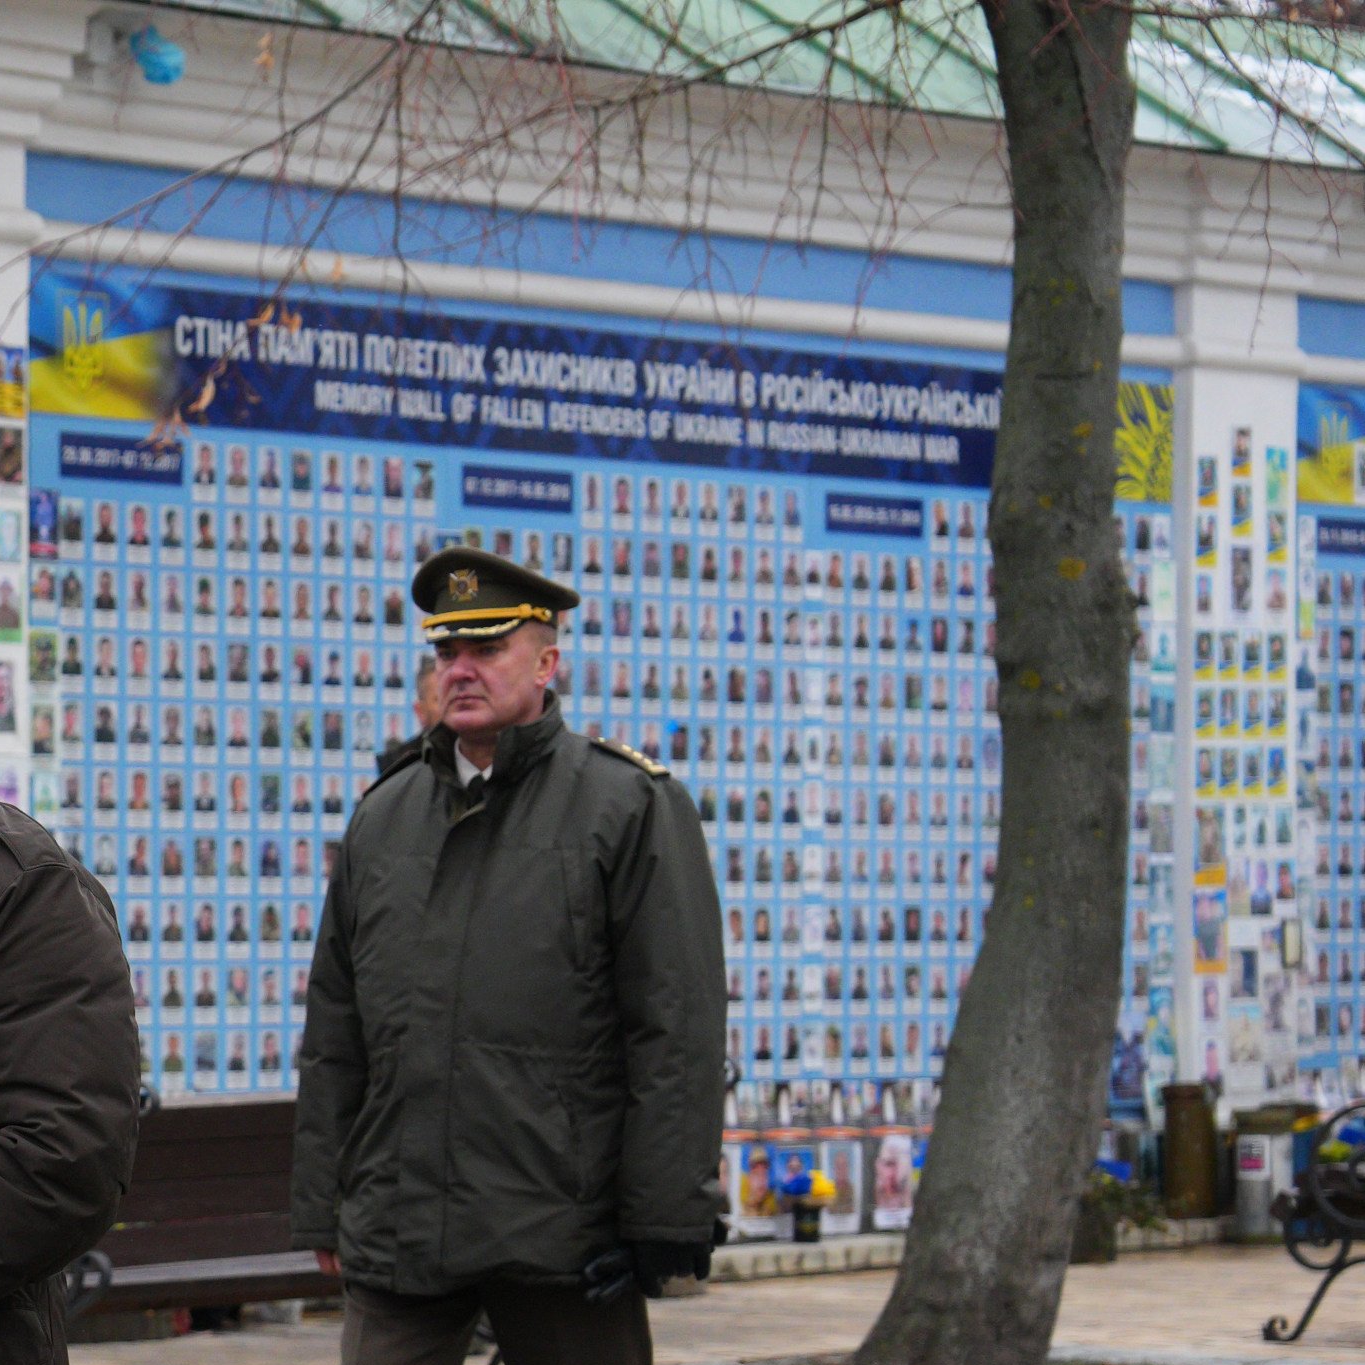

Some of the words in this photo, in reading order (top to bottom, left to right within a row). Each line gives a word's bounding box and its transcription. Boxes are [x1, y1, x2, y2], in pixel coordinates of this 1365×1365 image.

[174, 314, 251, 361] СТІНА
[363, 333, 486, 383] ПОЛЕГЛИХ
[493, 346, 637, 398] ЗАХИСНИКІВ
[643, 358, 736, 406] УКРАЇНИ
[740, 370, 756, 408] В
[314, 379, 394, 416] MEMORY
[397, 386, 446, 422] WALL
[450, 391, 476, 423] OF
[480, 395, 545, 430] FALLEN
[548, 401, 646, 439] DEFENDERS
[648, 409, 672, 440] OF
[673, 411, 742, 447] UKRAINE
[746, 419, 764, 449] IN
[768, 420, 922, 461] RUSSIAN-UKRAINIAN
[924, 434, 960, 464] WAR
